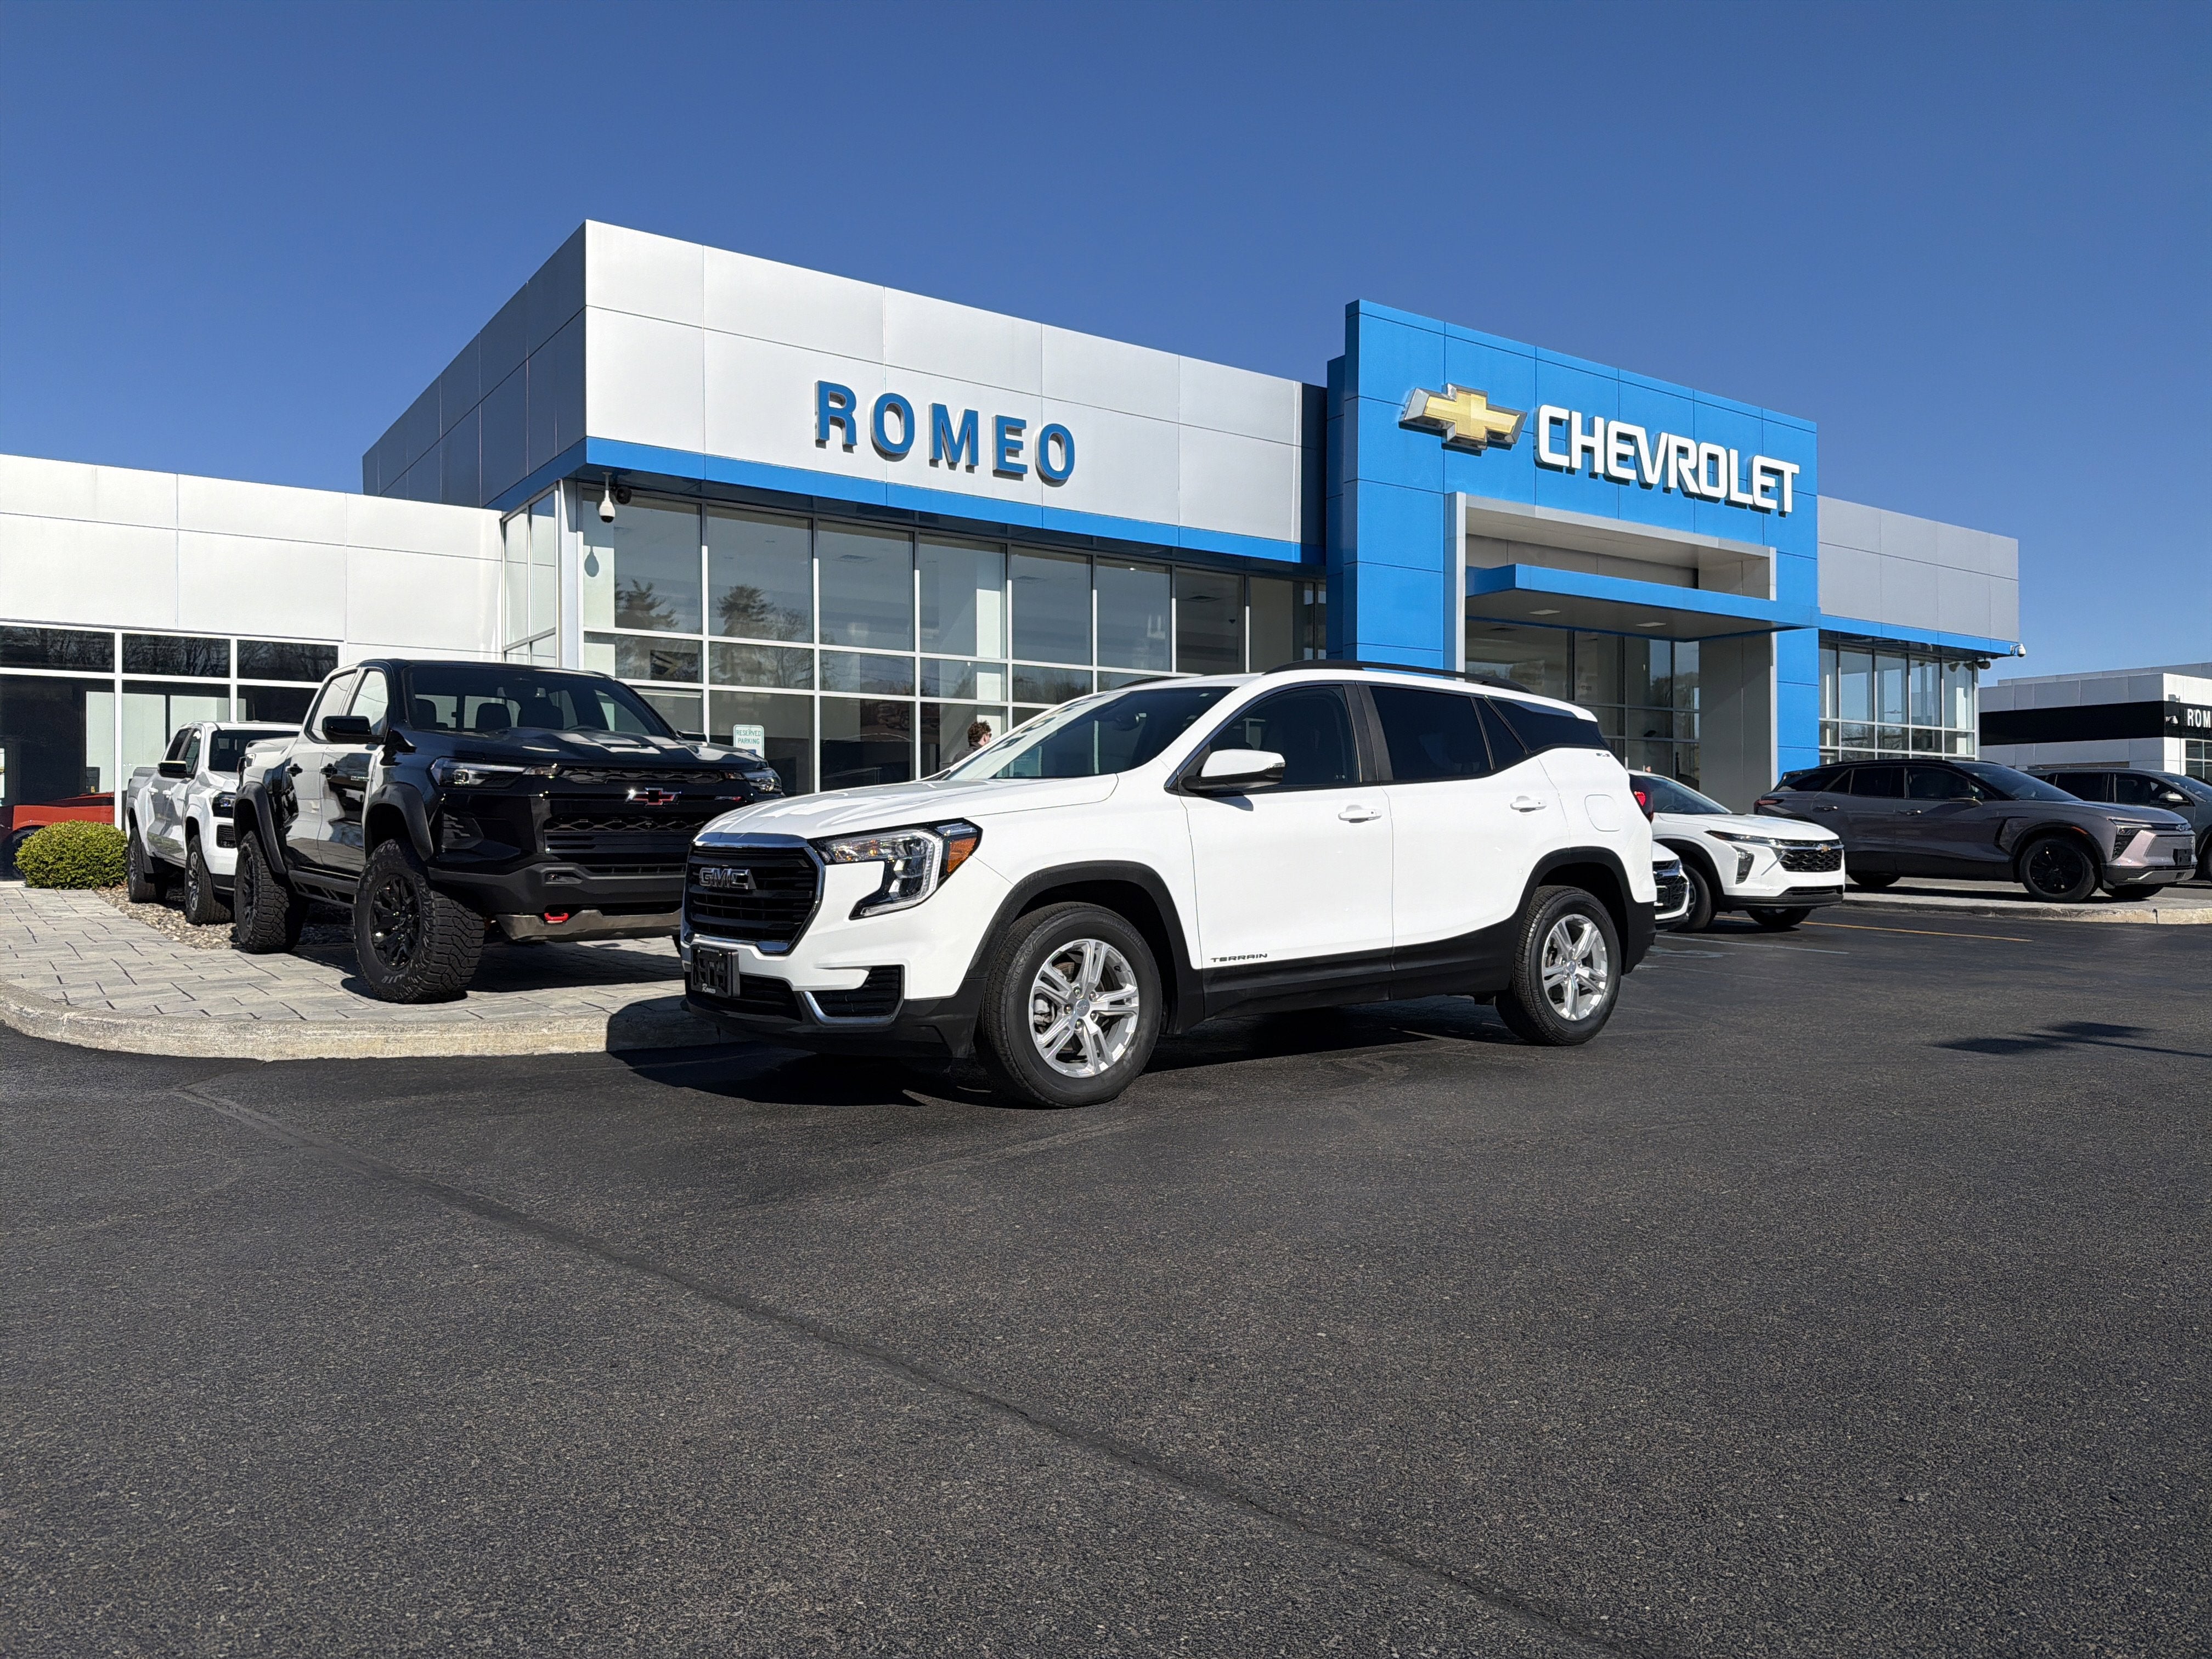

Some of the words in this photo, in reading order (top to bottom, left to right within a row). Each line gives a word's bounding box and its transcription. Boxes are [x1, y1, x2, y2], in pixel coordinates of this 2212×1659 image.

[815, 380, 1075, 481] ROMEO
[1536, 404, 1800, 514] CHEVROLET
[2187, 708, 2211, 728] ROM
[699, 867, 751, 890] GMC
[1210, 953, 1268, 963] TERRAIN
